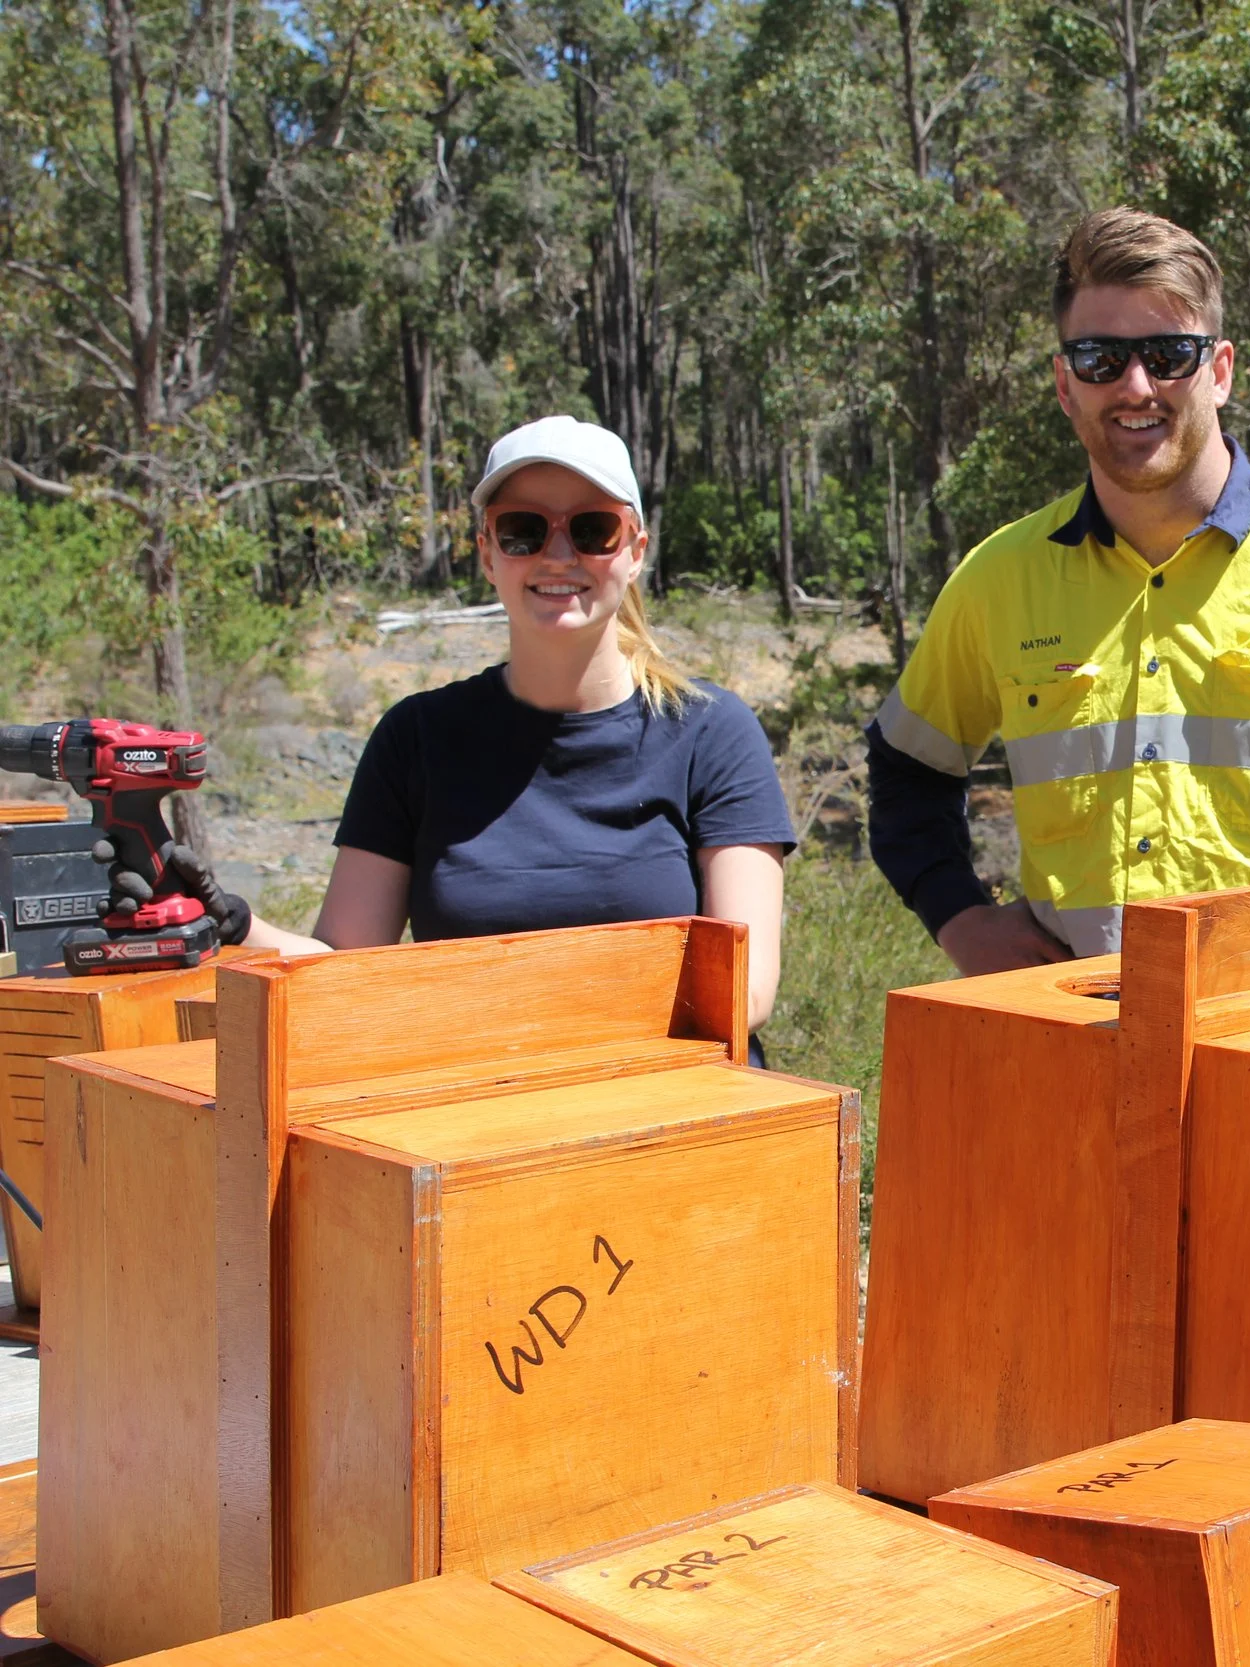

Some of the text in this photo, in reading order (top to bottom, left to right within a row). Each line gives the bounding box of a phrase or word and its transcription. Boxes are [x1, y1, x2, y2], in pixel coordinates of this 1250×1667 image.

[1020, 635, 1062, 651] NATHAN
[123, 749, 157, 761] ozito
[44, 896, 110, 918] GEEL
[79, 949, 103, 959] ozito
[484, 1234, 634, 1395] WD 1
[1057, 1458, 1179, 1493] PAR 1
[629, 1533, 788, 1590] PAR 2
